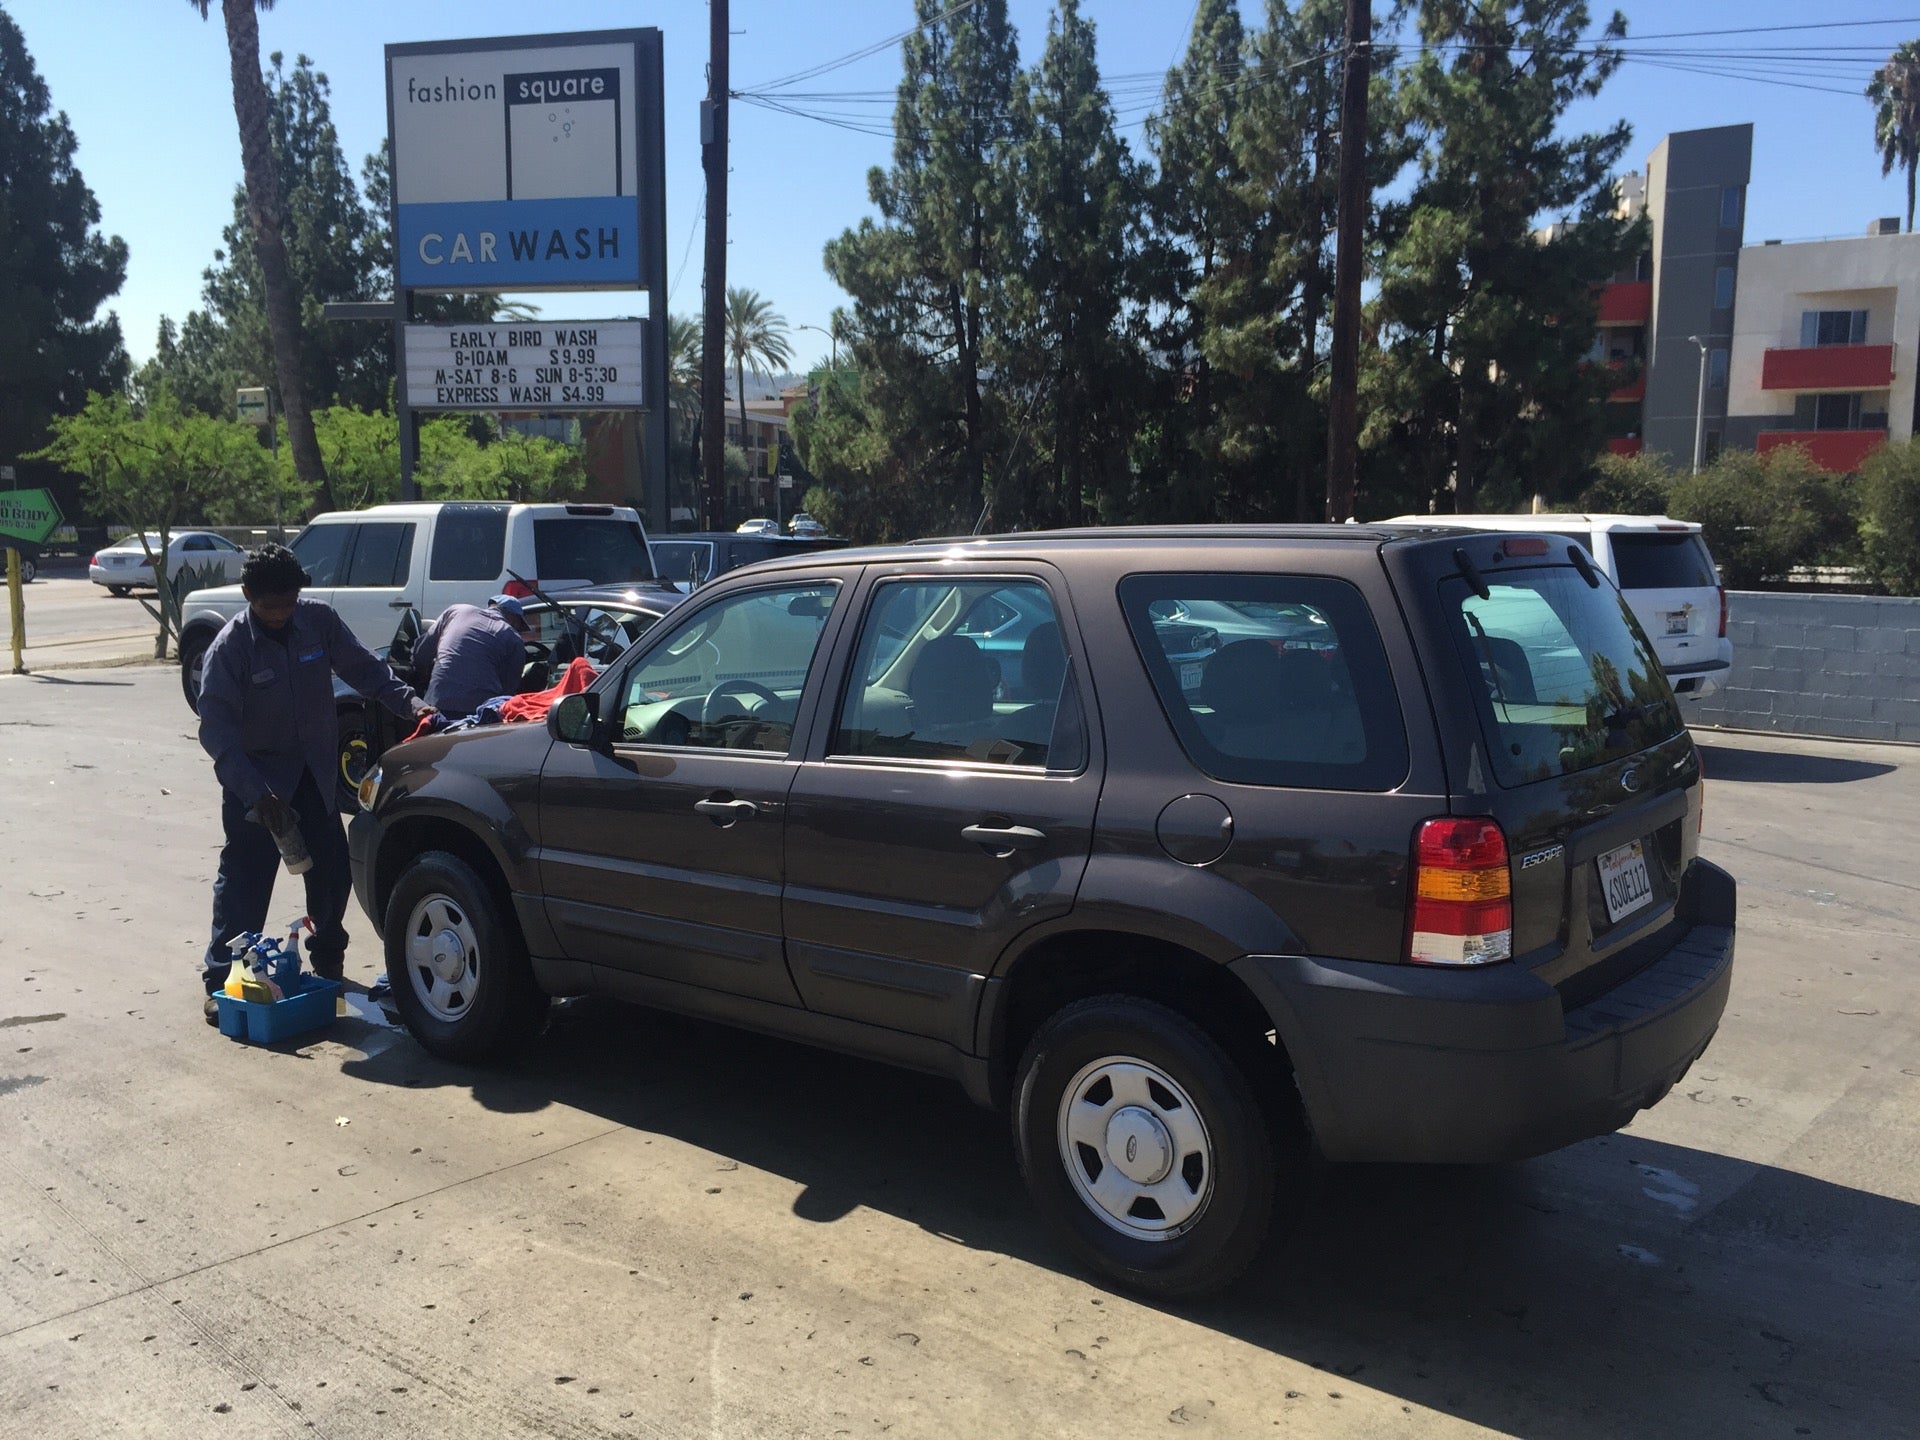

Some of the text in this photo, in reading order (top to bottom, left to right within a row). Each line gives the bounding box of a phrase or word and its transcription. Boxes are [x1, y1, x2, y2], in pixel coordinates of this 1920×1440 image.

[408, 76, 606, 104] fashion square
[418, 226, 620, 266] CAR WASH
[450, 329, 598, 348] EARLY BIRD WASH
[455, 350, 509, 366] 8-10AM
[435, 366, 618, 385] M-SAT 8-6 SUN 8-5:30
[436, 386, 499, 404] EXPRESS
[510, 386, 552, 403] WASH
[1520, 843, 1565, 871] ESCAPE
[1609, 863, 1651, 912] 6SUE112
